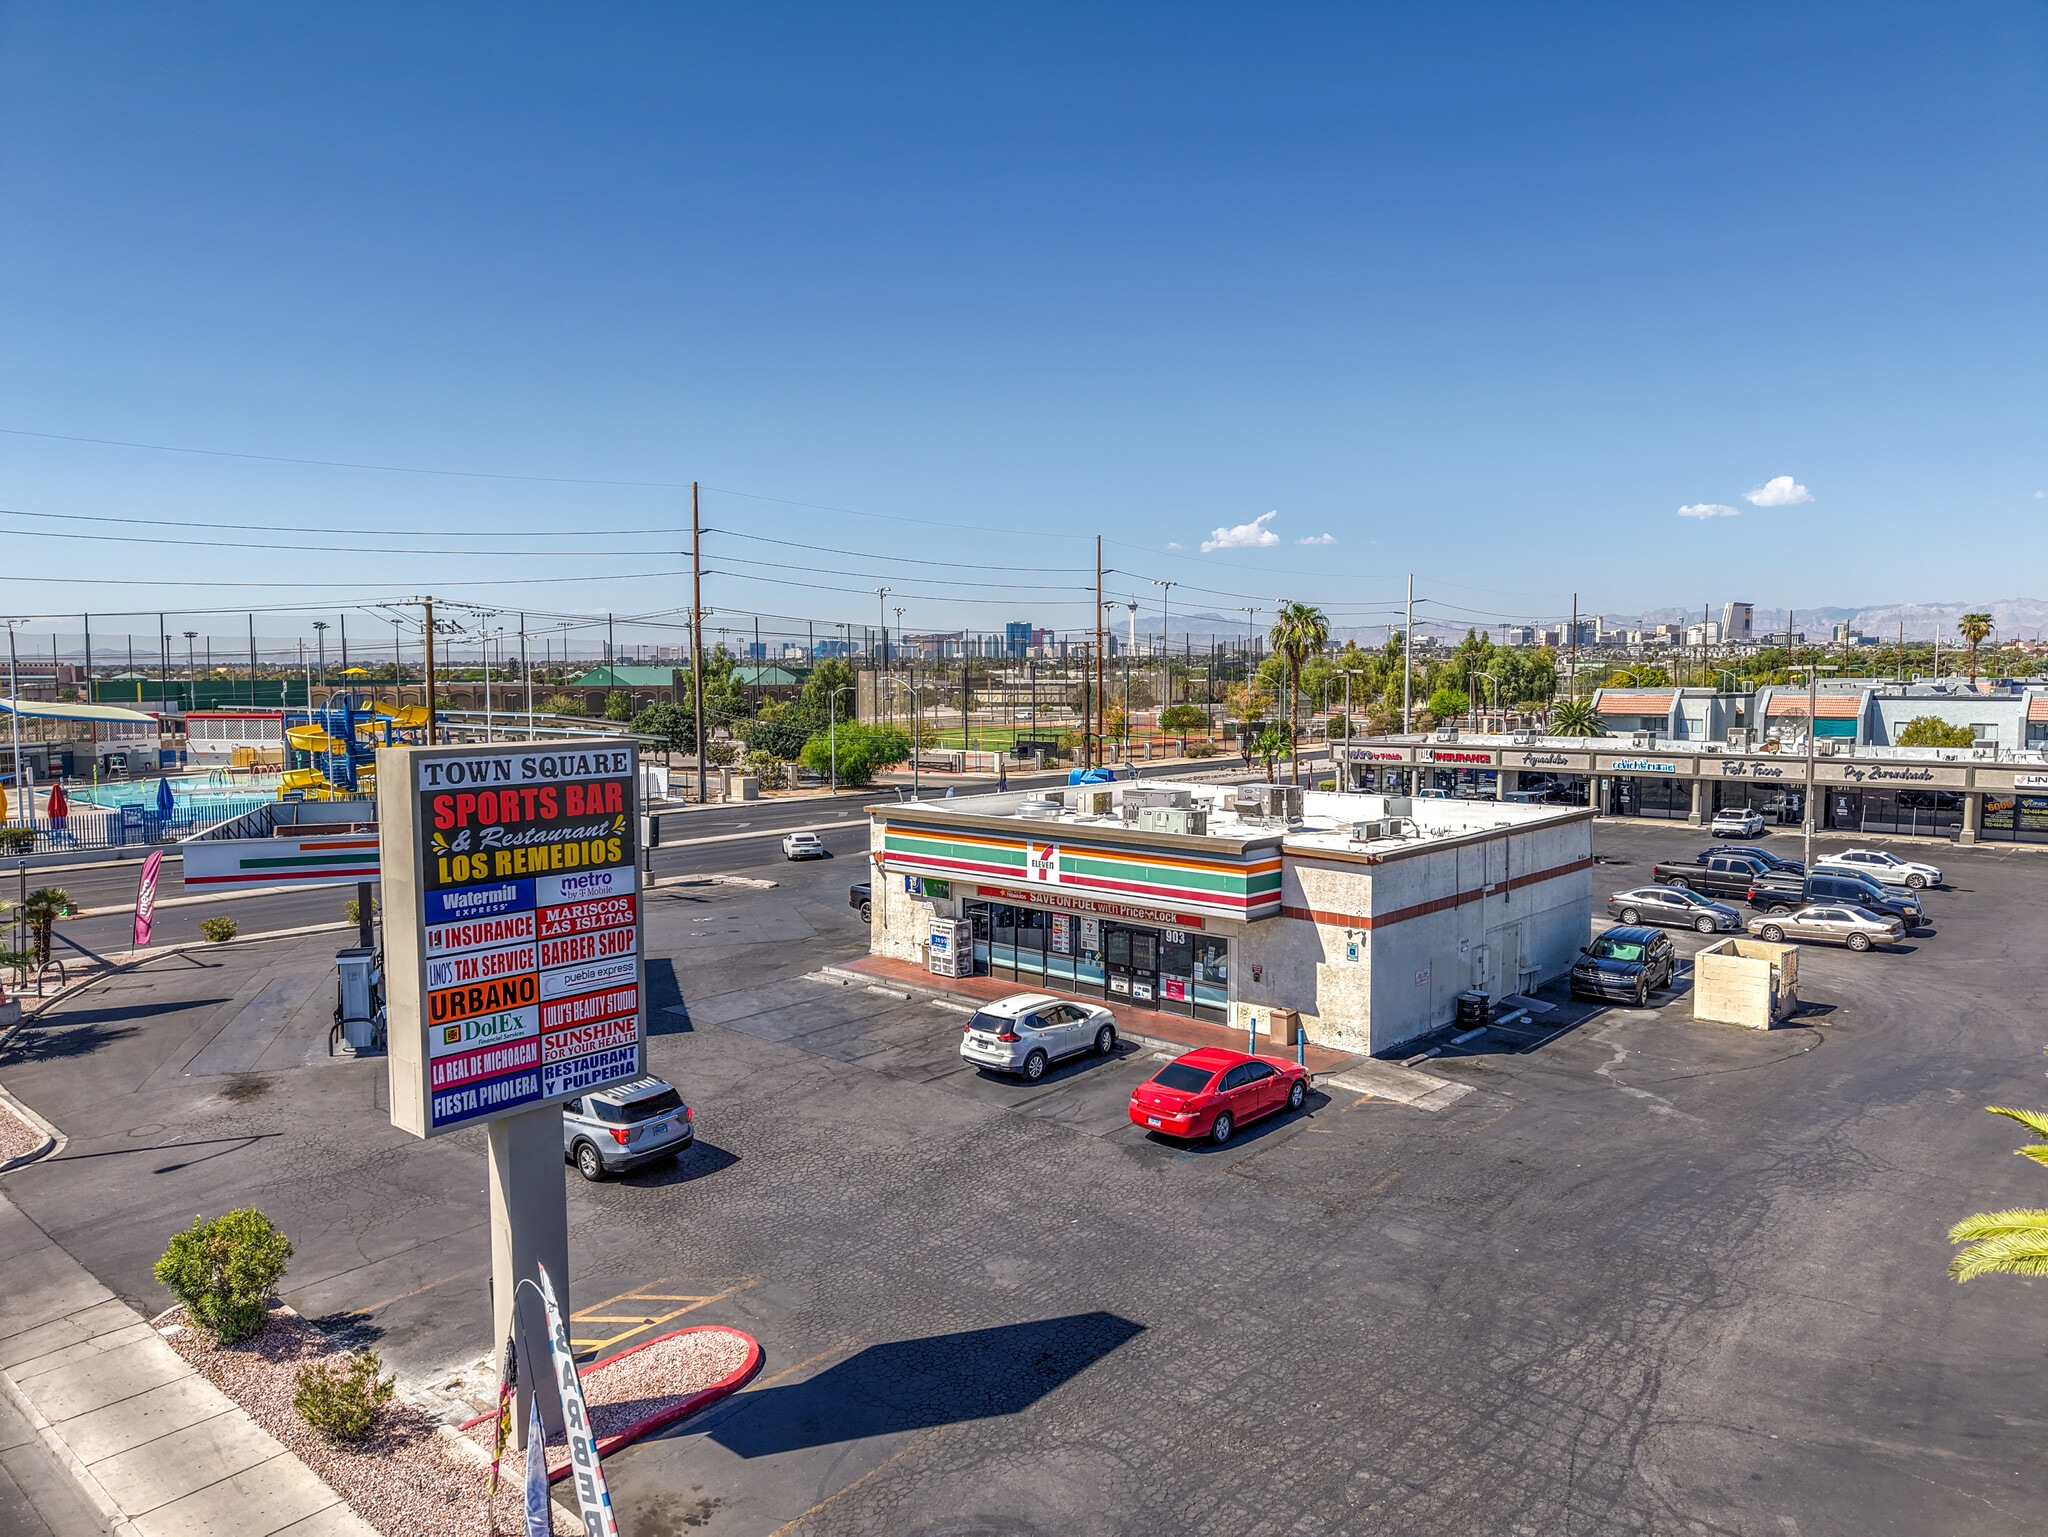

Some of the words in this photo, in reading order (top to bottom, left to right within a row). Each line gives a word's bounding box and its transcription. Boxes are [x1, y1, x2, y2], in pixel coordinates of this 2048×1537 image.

[424, 759, 512, 786] TOWN
[521, 752, 627, 779] SQUARE
[1435, 752, 1491, 764] INSURANCE
[433, 786, 558, 830] SPORTS
[566, 782, 622, 816] BAR
[451, 829, 471, 853] &
[479, 820, 610, 851] Restaurant
[438, 852, 488, 884] LOS
[495, 837, 622, 877] REMEDIOS
[443, 884, 516, 910] Watermill
[561, 872, 612, 890] metro
[567, 891, 577, 901] by
[933, 884, 949, 893] ATM
[456, 904, 505, 917] EXPRESS
[540, 921, 571, 936] LAS
[575, 910, 634, 931] ISLITAS
[546, 899, 629, 922] MARISCOS
[1029, 892, 1056, 905] SAVE
[1056, 897, 1071, 908] ON
[1073, 899, 1097, 912] FUEL
[1097, 902, 1119, 914] with
[1120, 905, 1145, 919] Price
[1154, 910, 1177, 923] Lock
[445, 916, 533, 949] INSURANCE
[541, 937, 595, 966] BARBER
[599, 929, 634, 955] SHOP
[1165, 930, 1185, 945] 903
[429, 962, 453, 987] LINO'S
[454, 957, 479, 982] TAX
[481, 948, 534, 976] SERVICE
[564, 969, 595, 985] puebla
[597, 963, 634, 977] express
[430, 977, 535, 1021] URBANO
[543, 1003, 572, 1028] LULU'S
[573, 995, 606, 1022] BEAUTY
[607, 989, 636, 1014] STUDIO
[464, 1013, 524, 1041] DolEx
[478, 1035, 503, 1045] Financial
[504, 1031, 525, 1041] Services
[544, 1018, 636, 1051] SUNSHINE
[544, 1049, 566, 1061] FOR
[568, 1043, 596, 1056] YOUR
[598, 1032, 637, 1049] HEALTH
[432, 1064, 447, 1085] LA
[447, 1060, 469, 1081] REAL
[470, 1056, 483, 1076] DE
[483, 1042, 537, 1073] MICHOACAN
[544, 1046, 636, 1080] RESTAURANT
[545, 1081, 555, 1094] Y
[563, 1061, 636, 1091] PULPERIA
[434, 1087, 477, 1119] FIESTA
[479, 1074, 538, 1108] PINOLERA
